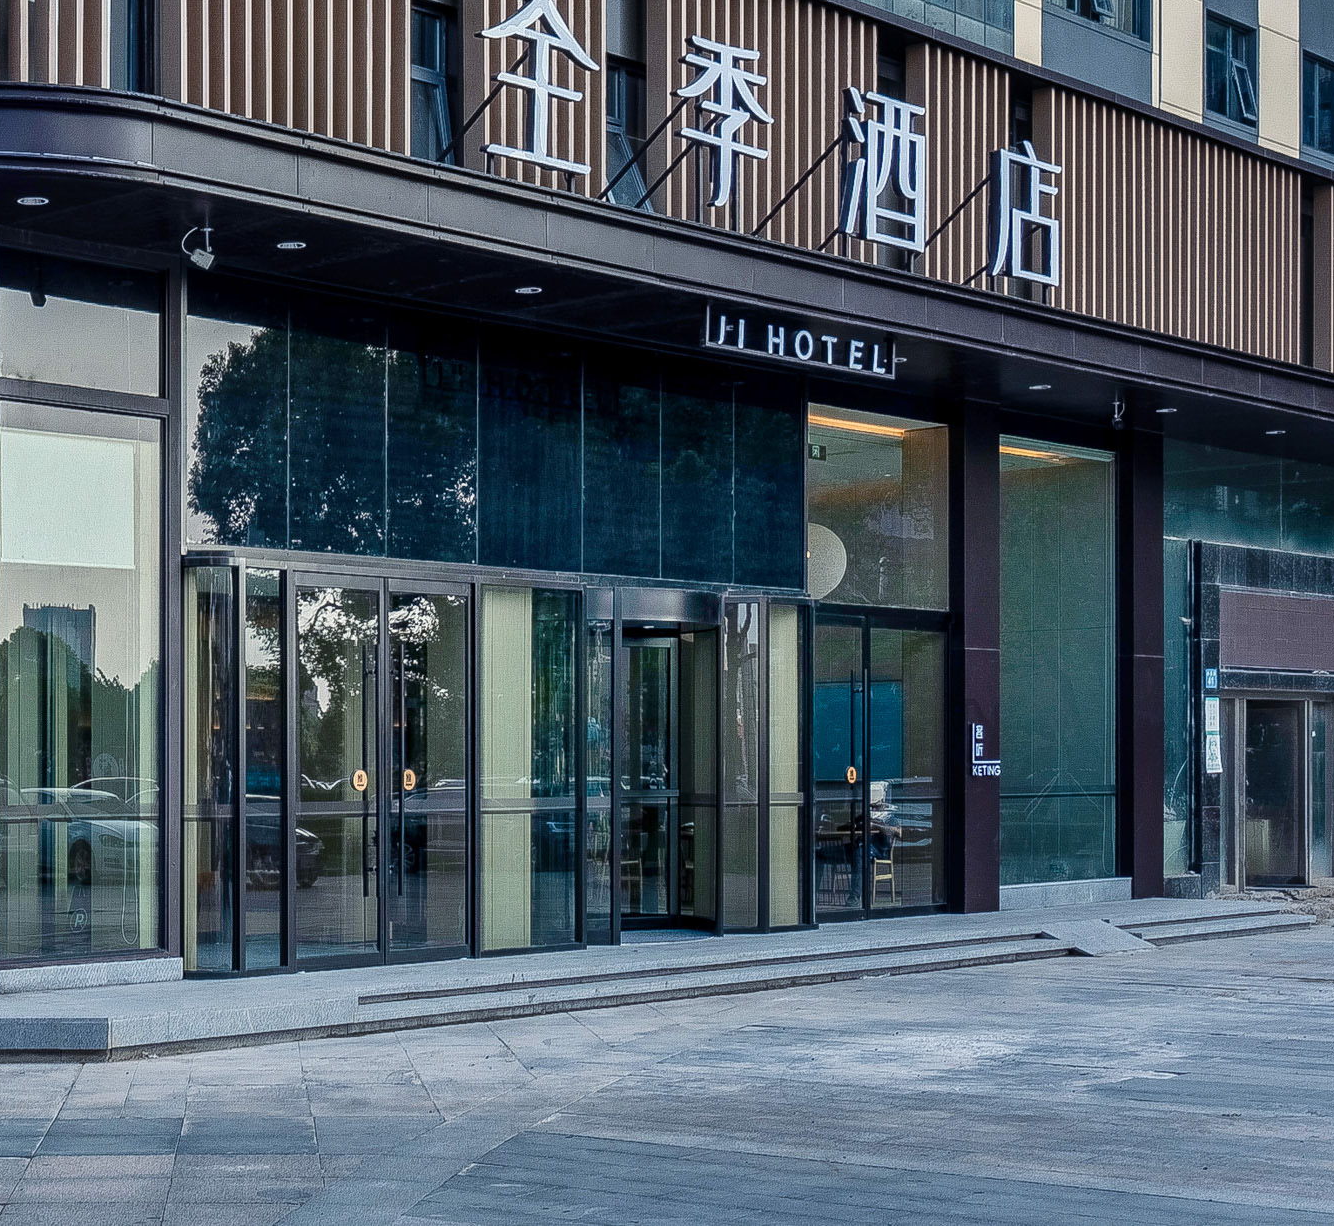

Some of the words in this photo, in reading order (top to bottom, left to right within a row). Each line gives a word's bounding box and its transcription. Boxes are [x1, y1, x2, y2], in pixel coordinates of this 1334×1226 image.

[718, 315, 745, 350] JI
[768, 324, 886, 375] HOTEL
[972, 765, 1001, 777] KETING
